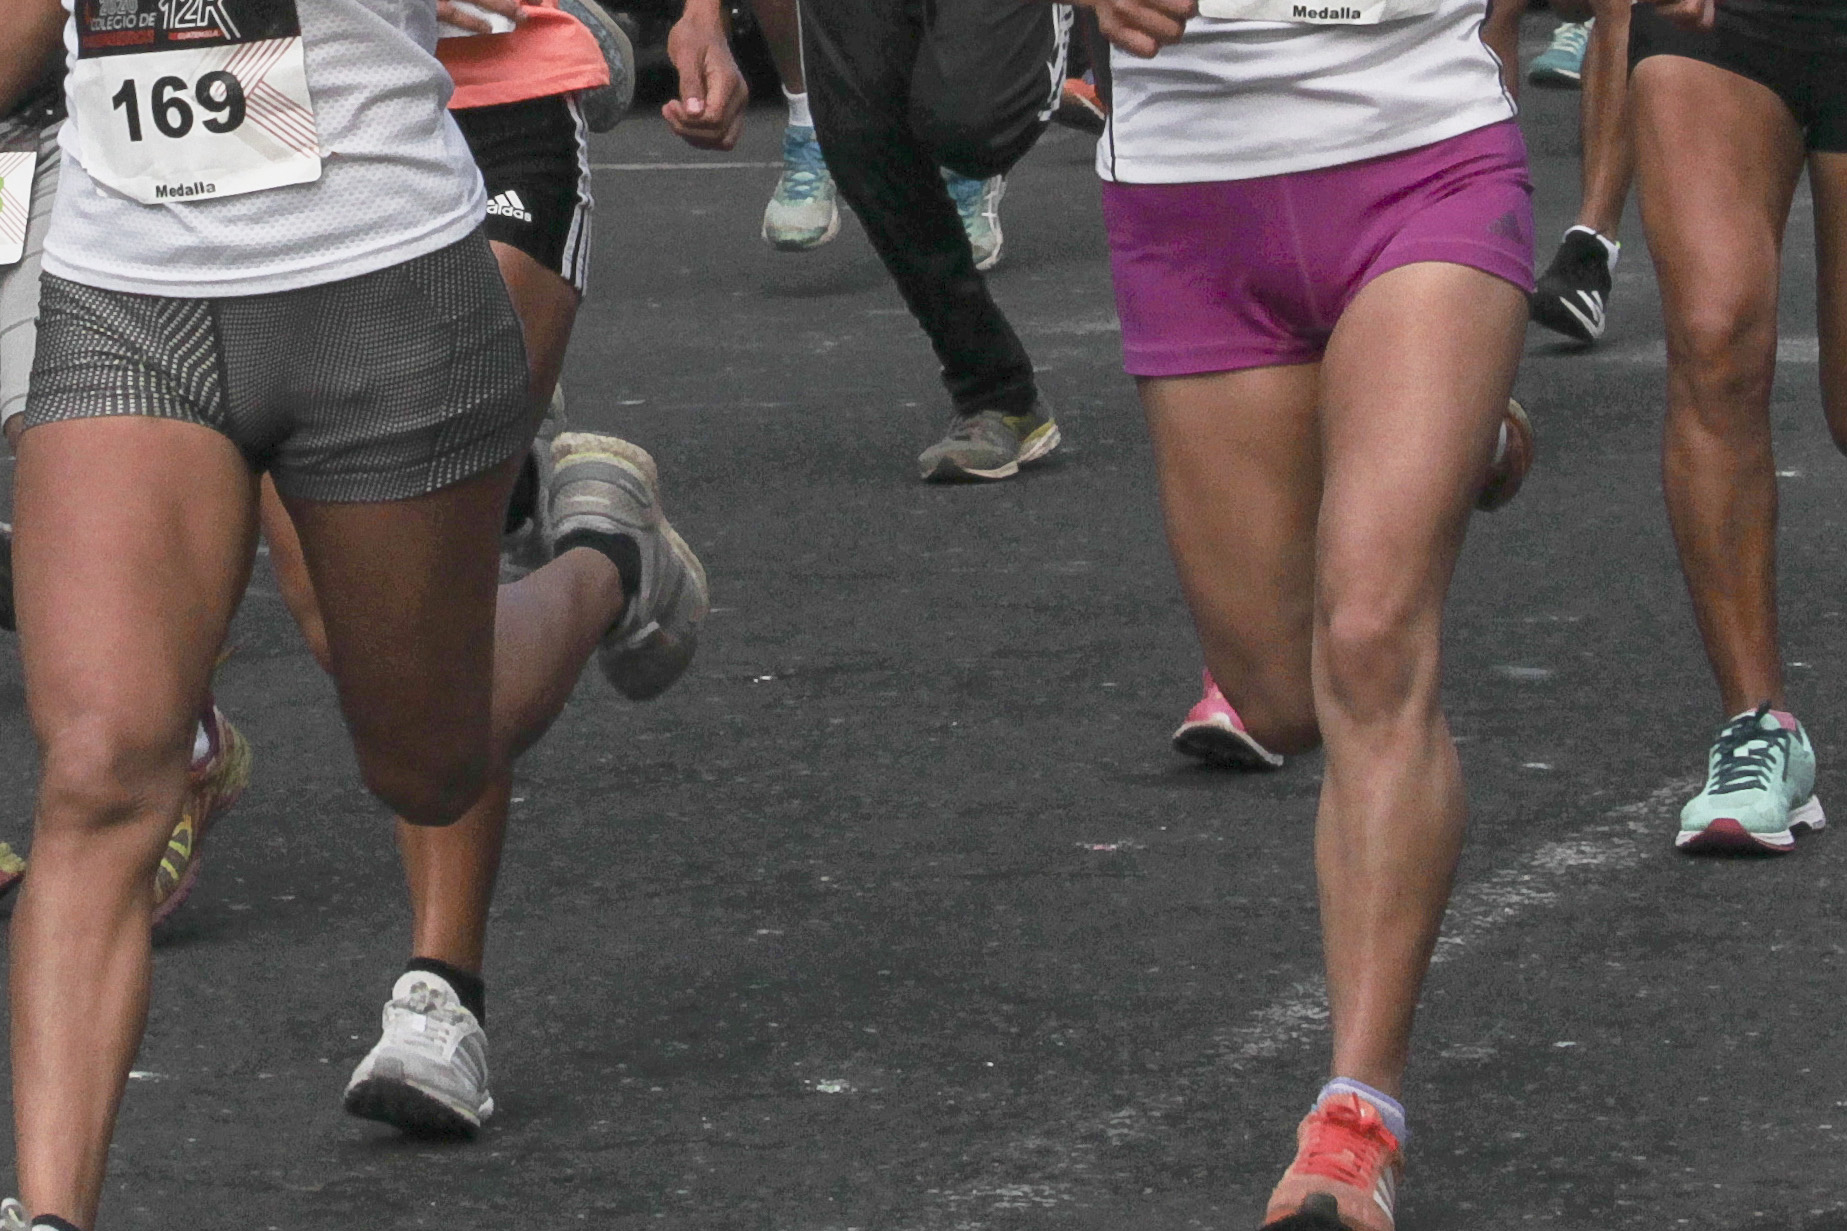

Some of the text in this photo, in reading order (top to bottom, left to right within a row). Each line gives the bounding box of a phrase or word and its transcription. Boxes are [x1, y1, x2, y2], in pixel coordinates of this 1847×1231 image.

[138, 11, 157, 28] DE
[1293, 4, 1361, 20] Medalla
[112, 70, 247, 143] 169
[155, 181, 217, 198] Medalla
